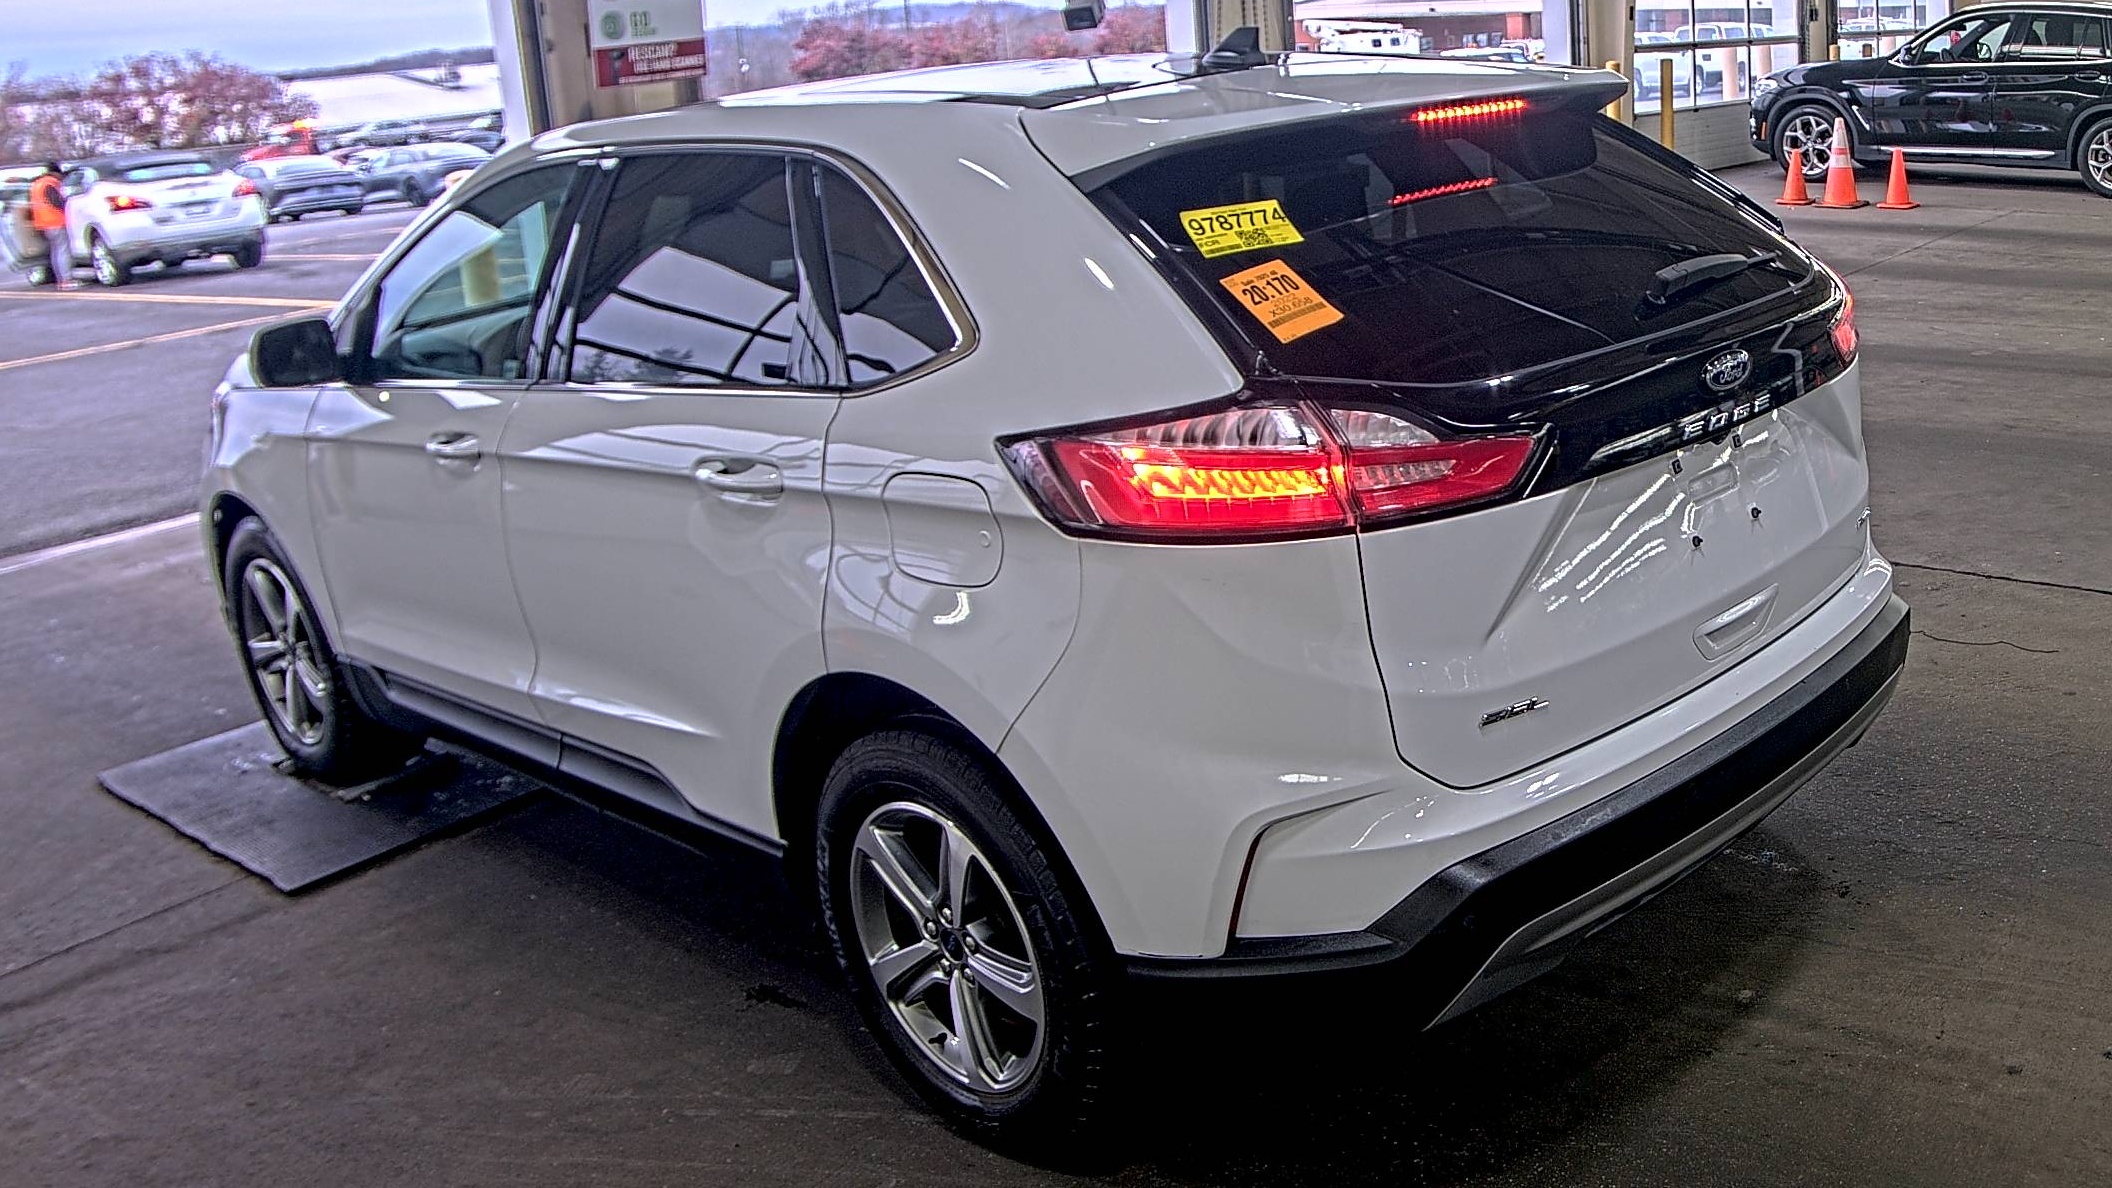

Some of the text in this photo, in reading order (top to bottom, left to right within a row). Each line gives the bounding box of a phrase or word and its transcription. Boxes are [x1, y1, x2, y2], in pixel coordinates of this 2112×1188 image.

[1188, 207, 1286, 236] 9787774
[1242, 274, 1300, 306] 20:170
[1683, 394, 1771, 441] EDGE
